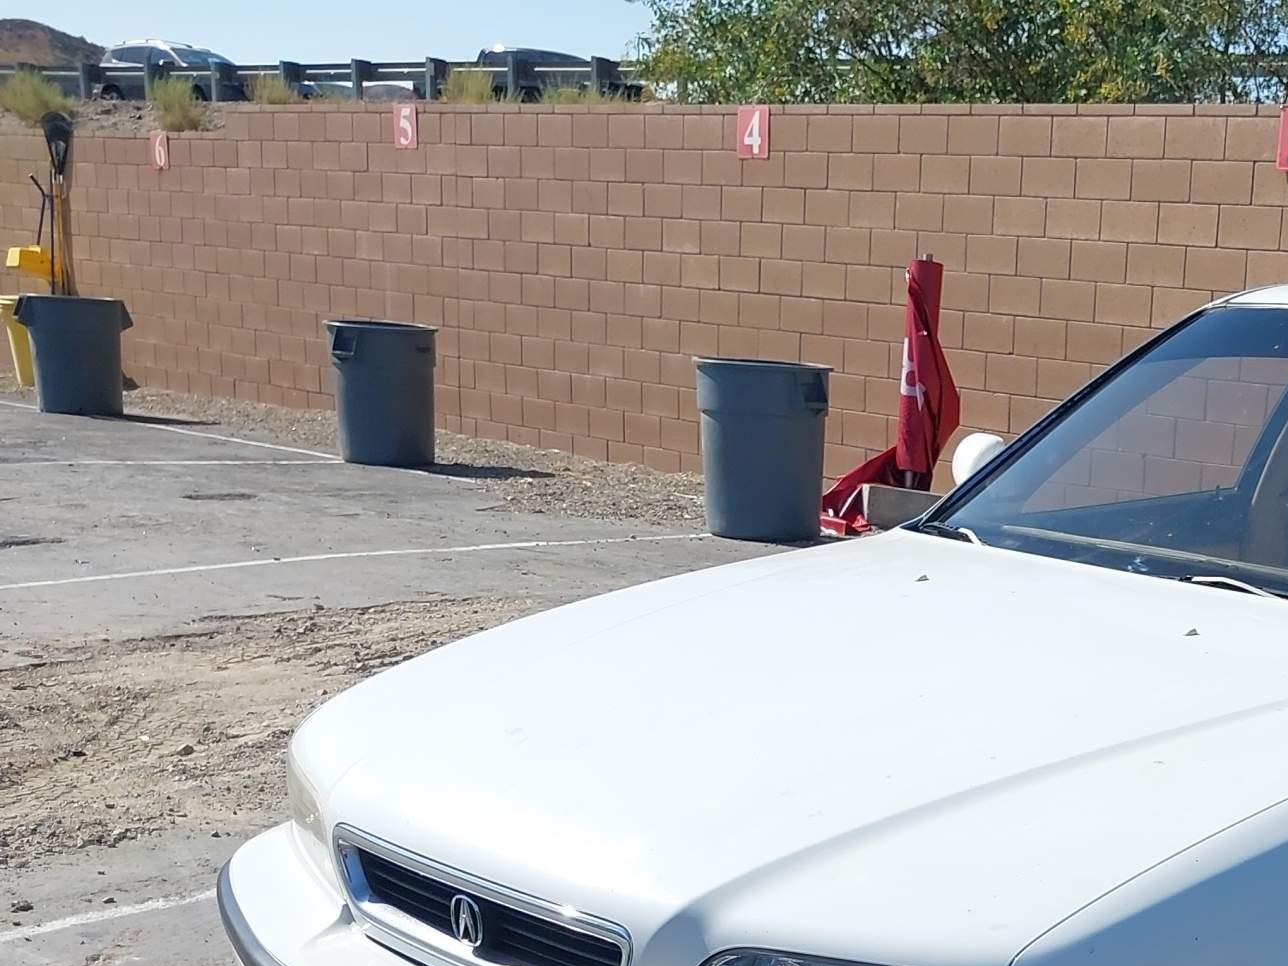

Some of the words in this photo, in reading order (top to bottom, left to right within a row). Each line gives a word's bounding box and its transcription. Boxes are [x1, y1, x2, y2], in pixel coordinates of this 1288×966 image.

[399, 107, 412, 145] 5
[743, 110, 762, 154] 4
[155, 135, 165, 167] 6
